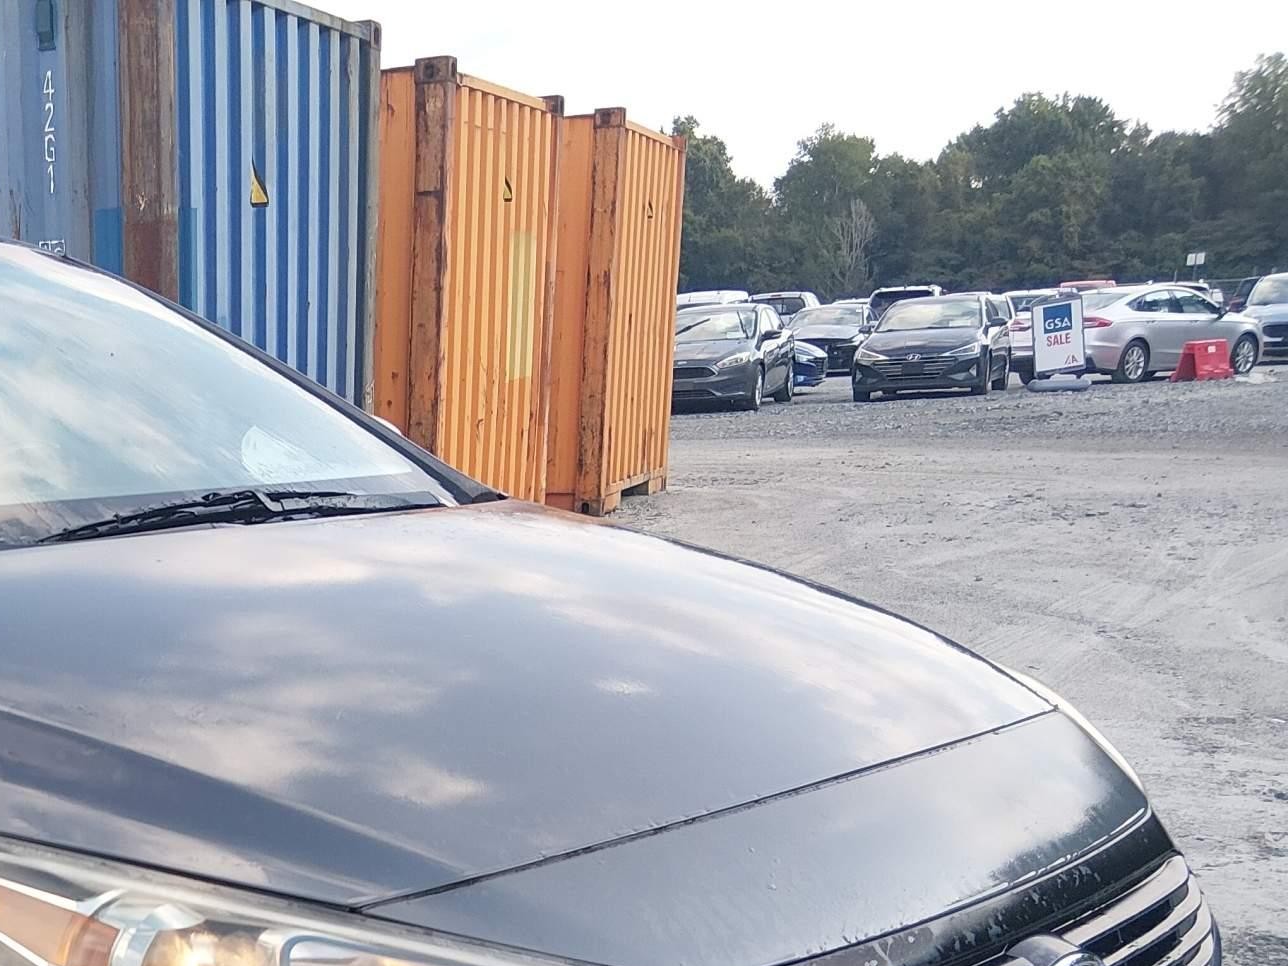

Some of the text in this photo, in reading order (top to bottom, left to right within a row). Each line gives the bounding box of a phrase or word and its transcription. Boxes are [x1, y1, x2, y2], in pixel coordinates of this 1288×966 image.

[43, 70, 56, 194] 42G1
[1045, 317, 1071, 330] GSA
[1046, 333, 1071, 347] SALE
